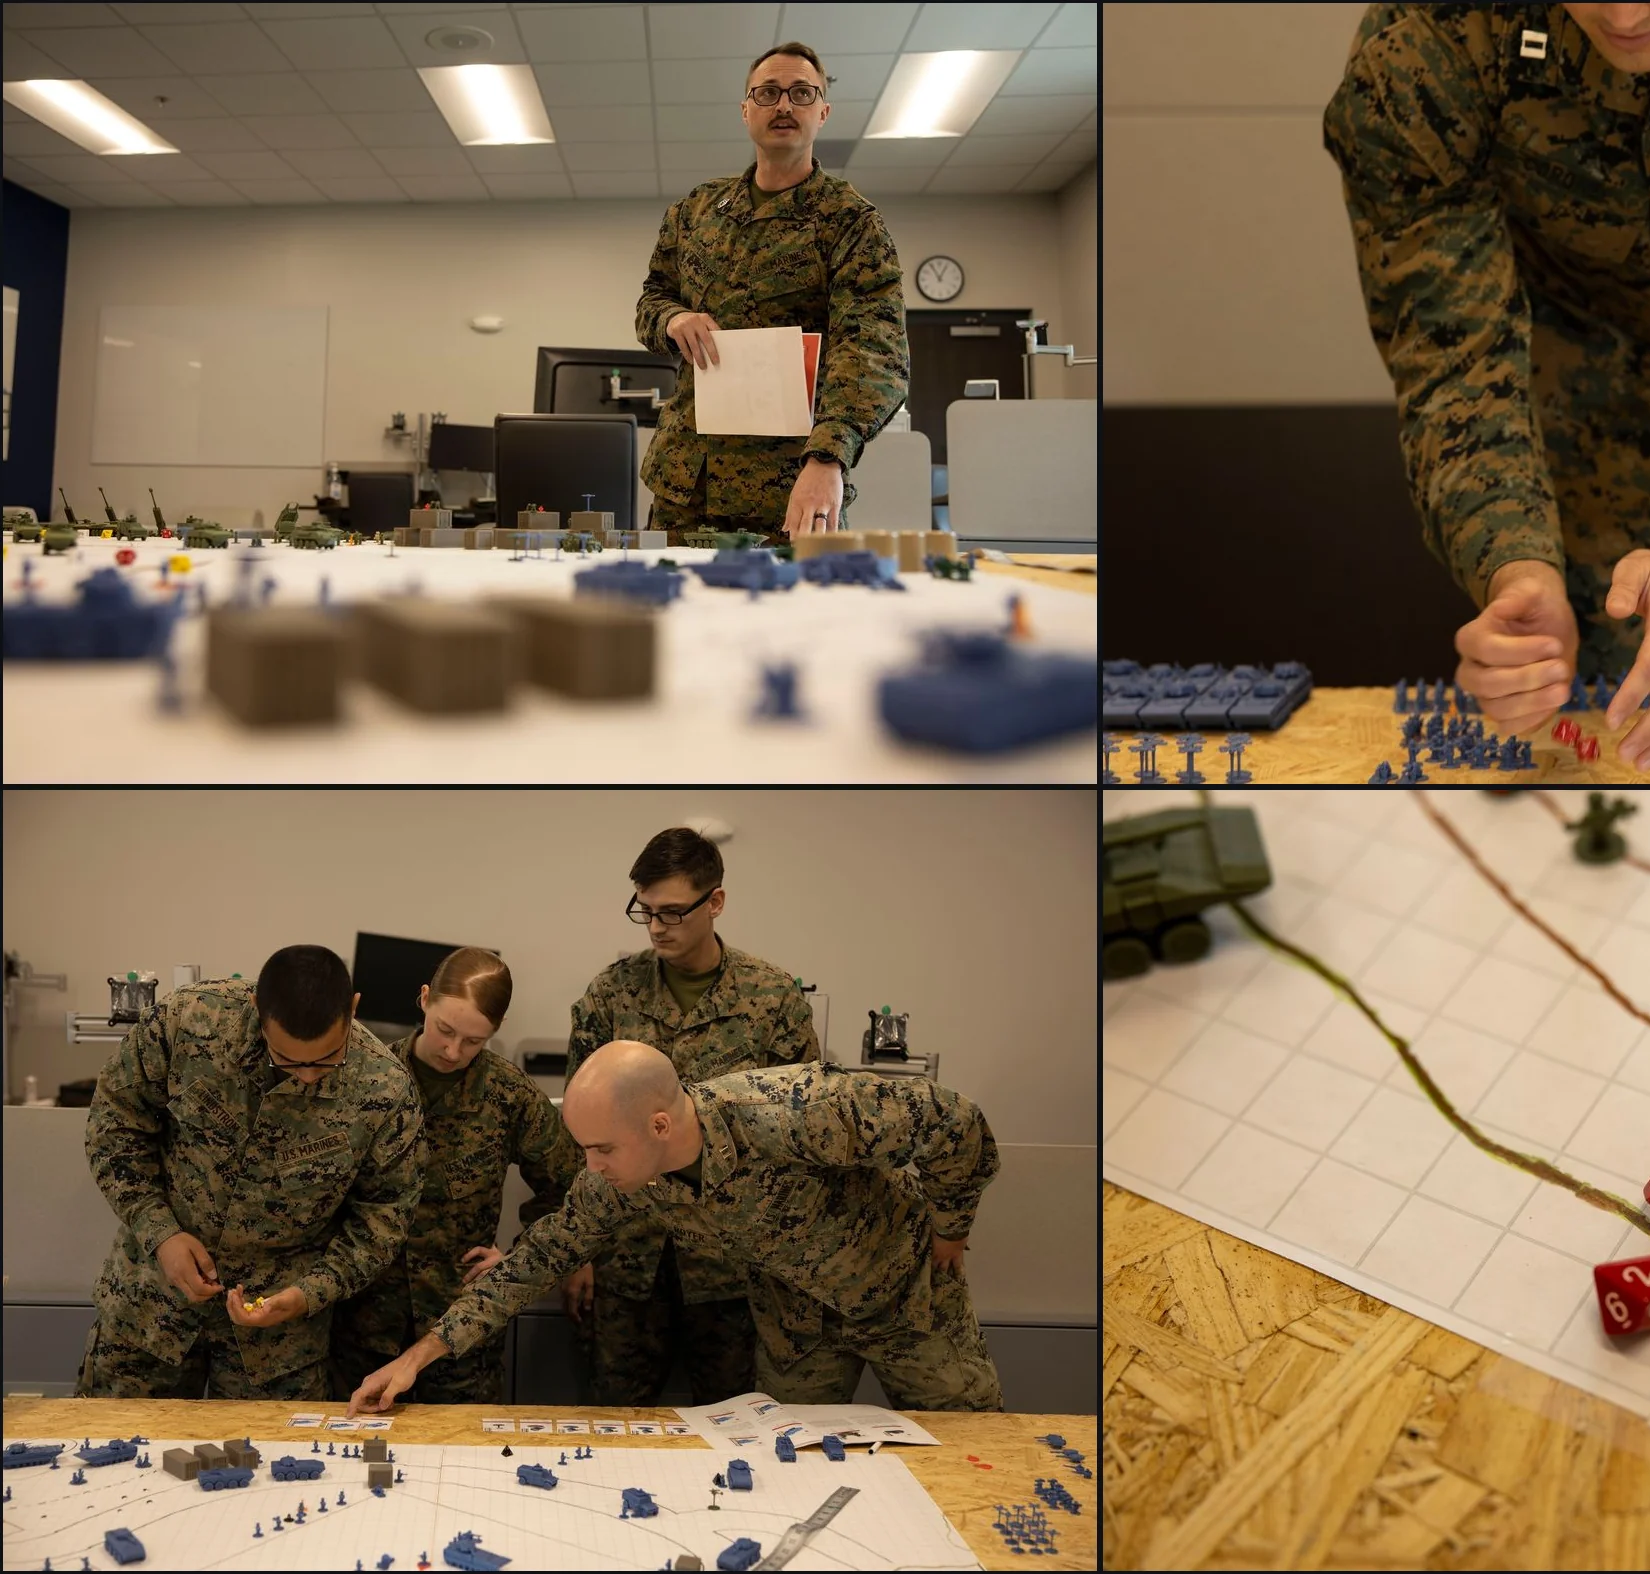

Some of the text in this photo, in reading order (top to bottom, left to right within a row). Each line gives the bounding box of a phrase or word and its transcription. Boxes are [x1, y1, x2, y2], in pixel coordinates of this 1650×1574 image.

[769, 250, 808, 269] MARINES
[282, 1135, 340, 1161] U.S. MARINES
